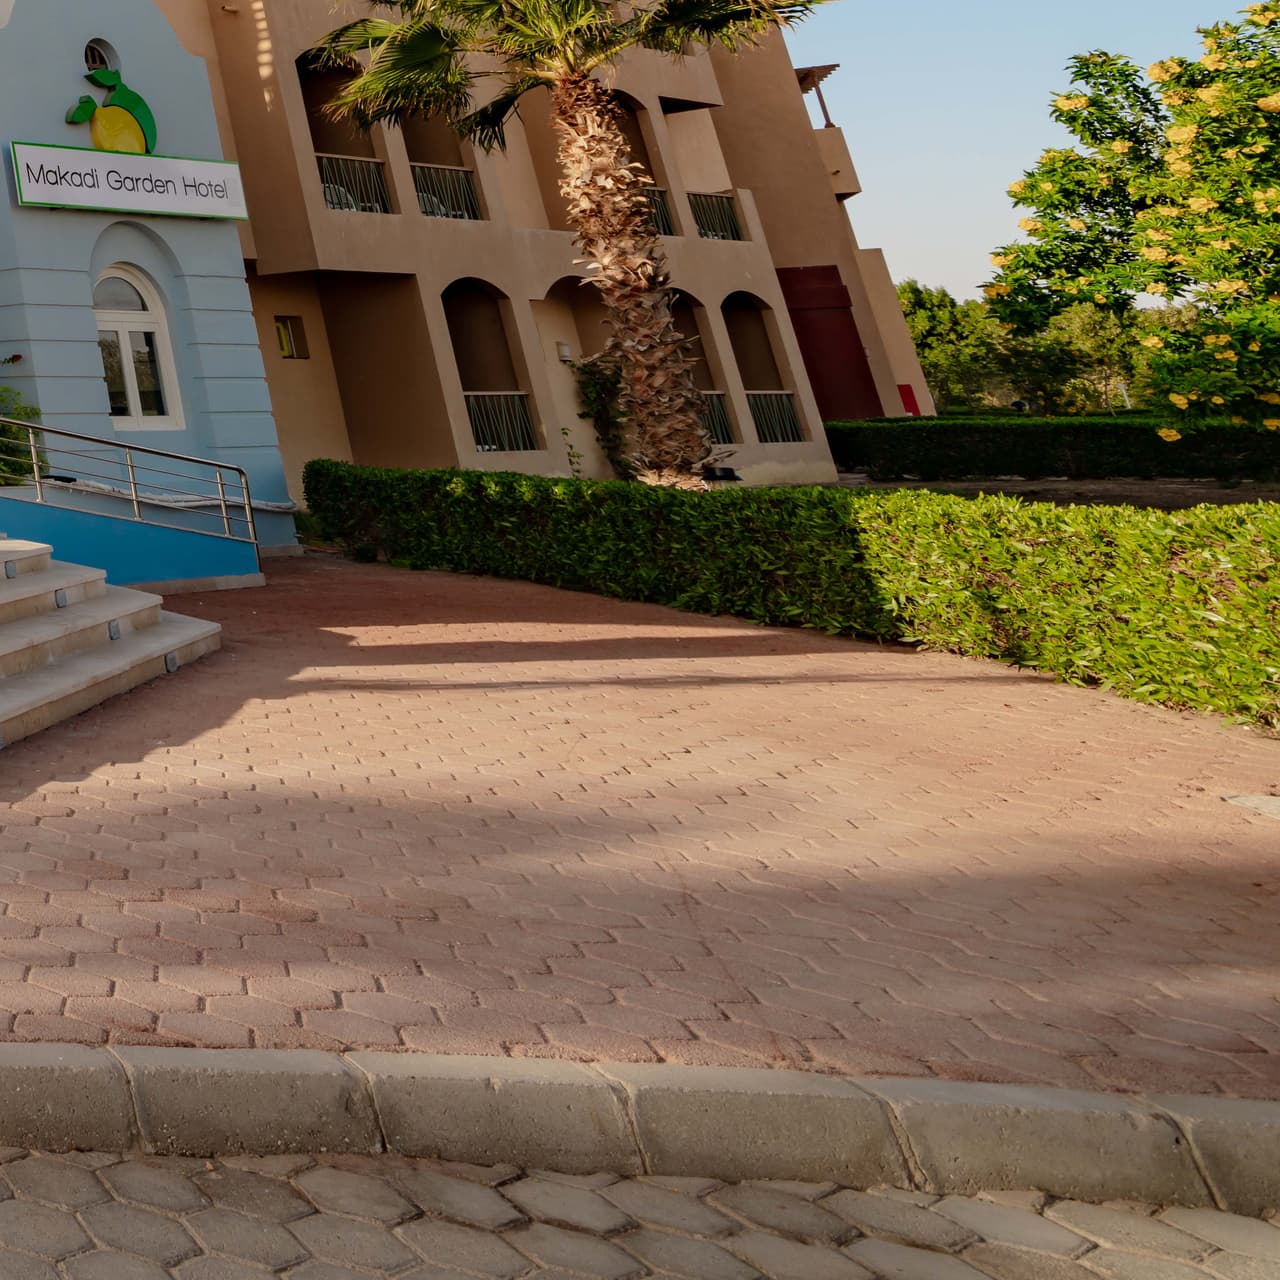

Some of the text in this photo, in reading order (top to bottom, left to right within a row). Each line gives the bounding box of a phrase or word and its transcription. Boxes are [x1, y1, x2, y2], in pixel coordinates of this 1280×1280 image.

[26, 162, 229, 200] Makadi Garden Hotel
